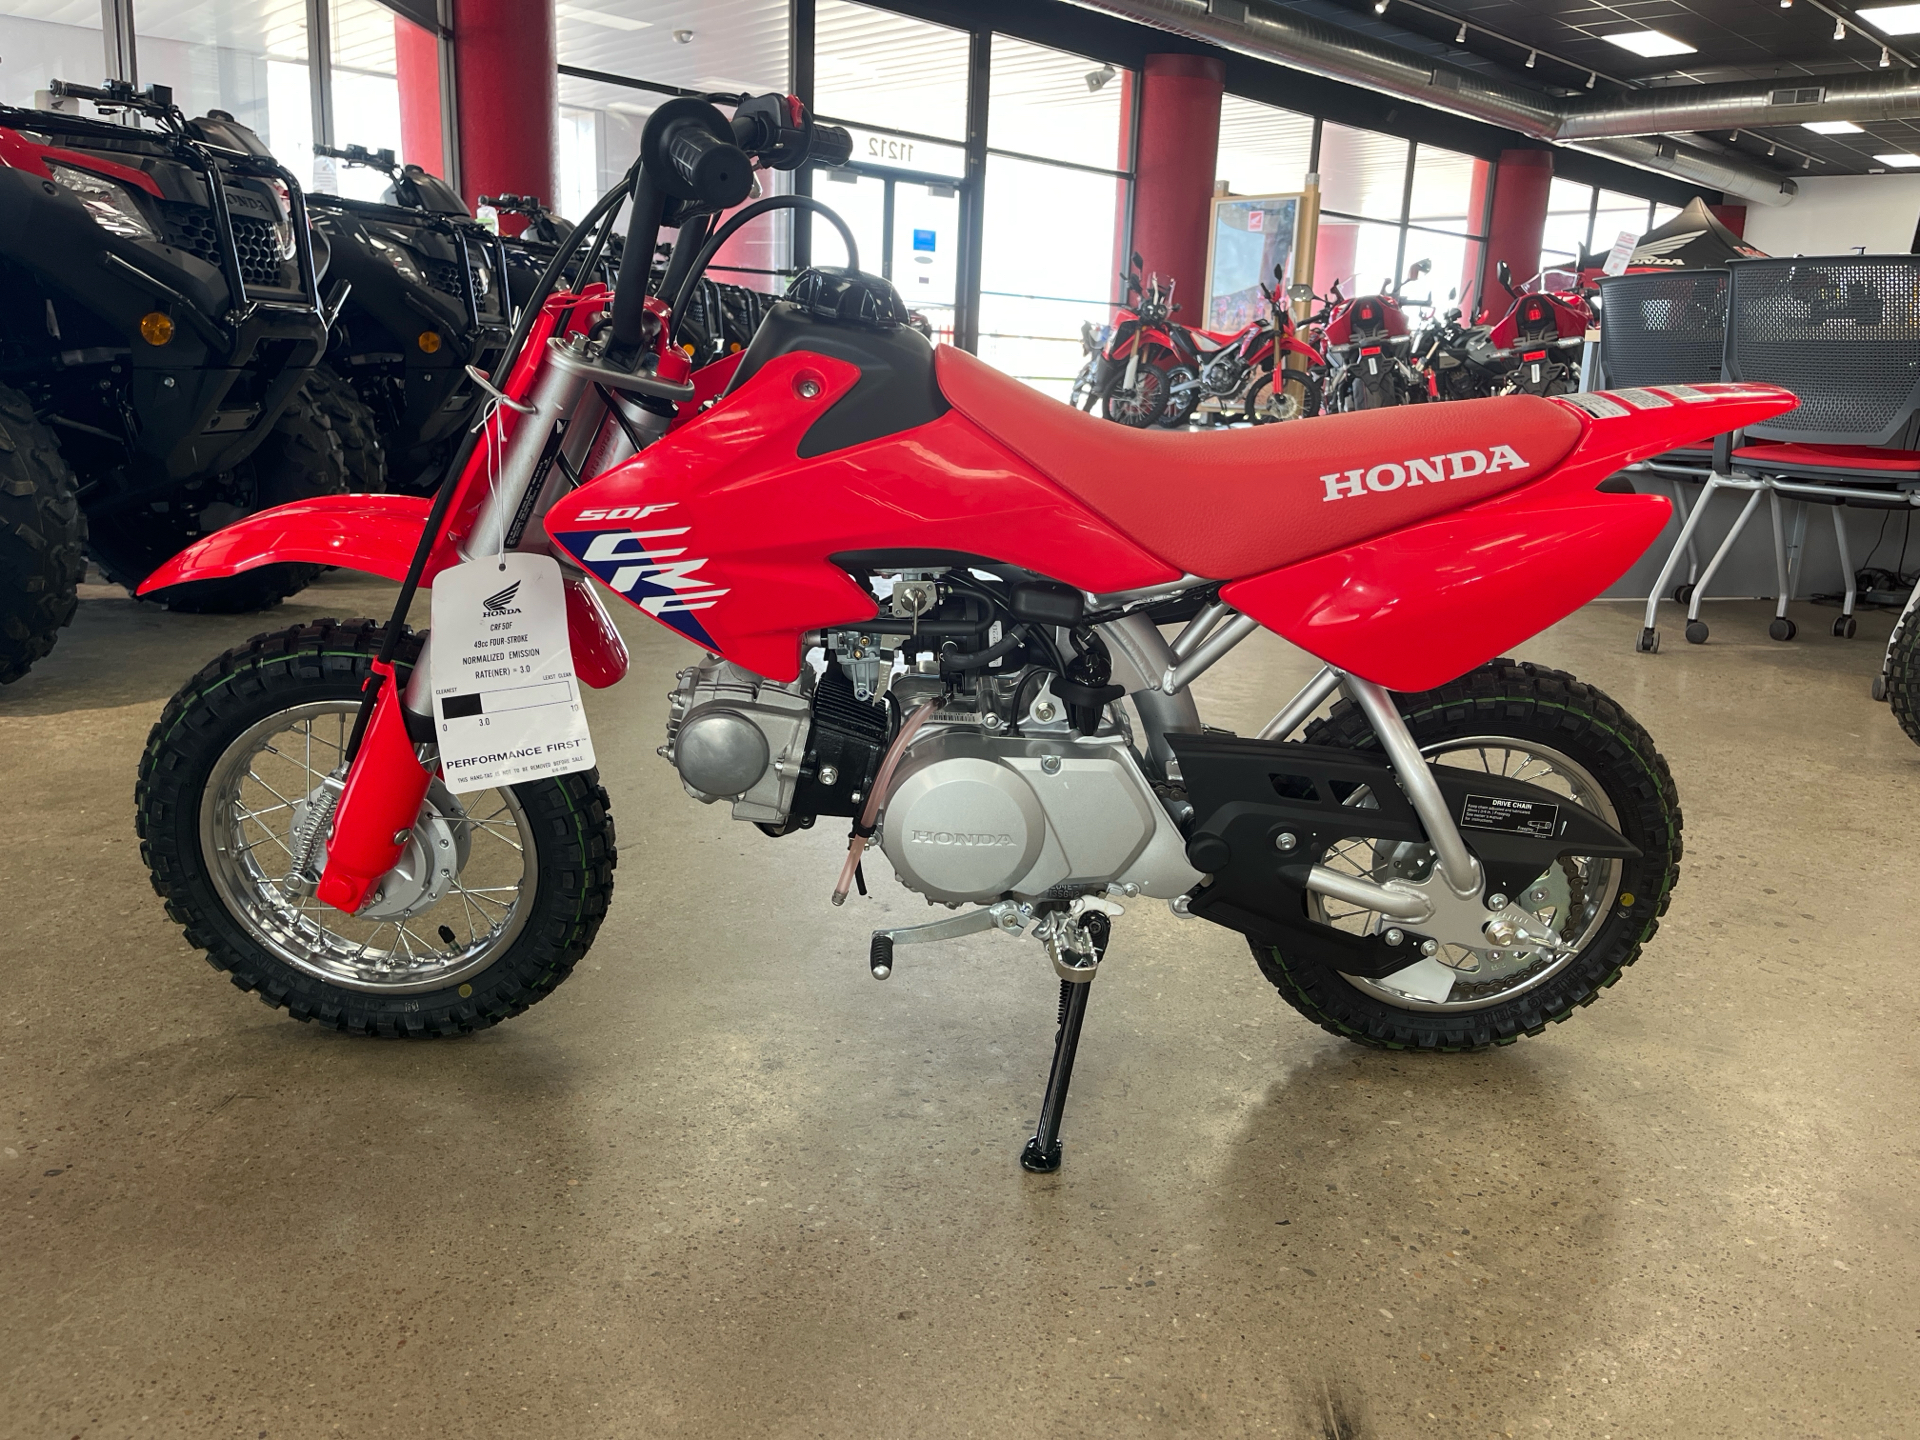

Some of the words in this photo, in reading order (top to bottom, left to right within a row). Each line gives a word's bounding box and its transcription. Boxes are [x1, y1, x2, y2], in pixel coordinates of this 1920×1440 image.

[226, 193, 270, 212] ONDA
[1628, 258, 1686, 266] ONDA
[1319, 444, 1530, 502] HONDA
[574, 502, 680, 522] 50F
[582, 526, 732, 617] CRF
[482, 608, 522, 618] HONDA
[490, 622, 513, 631] CRF50F
[473, 640, 488, 648] 49cc
[489, 634, 528, 647] FOUR-STROKE
[462, 653, 505, 665] NORMALIZED
[509, 648, 540, 660] EMISSION
[475, 667, 510, 679] RATE(NER)
[520, 665, 531, 674] 3.0
[436, 687, 457, 695] CLEANEST
[442, 724, 448, 732] 0
[479, 718, 490, 727] 3.0
[446, 746, 543, 770] PERFORMANCE
[470, 773, 493, 781] HANG-TAG
[553, 759, 570, 767] BEFORE
[1492, 800, 1511, 808] DRIVE
[1512, 802, 1533, 810] CHAIN
[911, 829, 1017, 847] HONDA
[1527, 962, 1591, 1010] CHENG
[1473, 1000, 1523, 1027] SHIN
